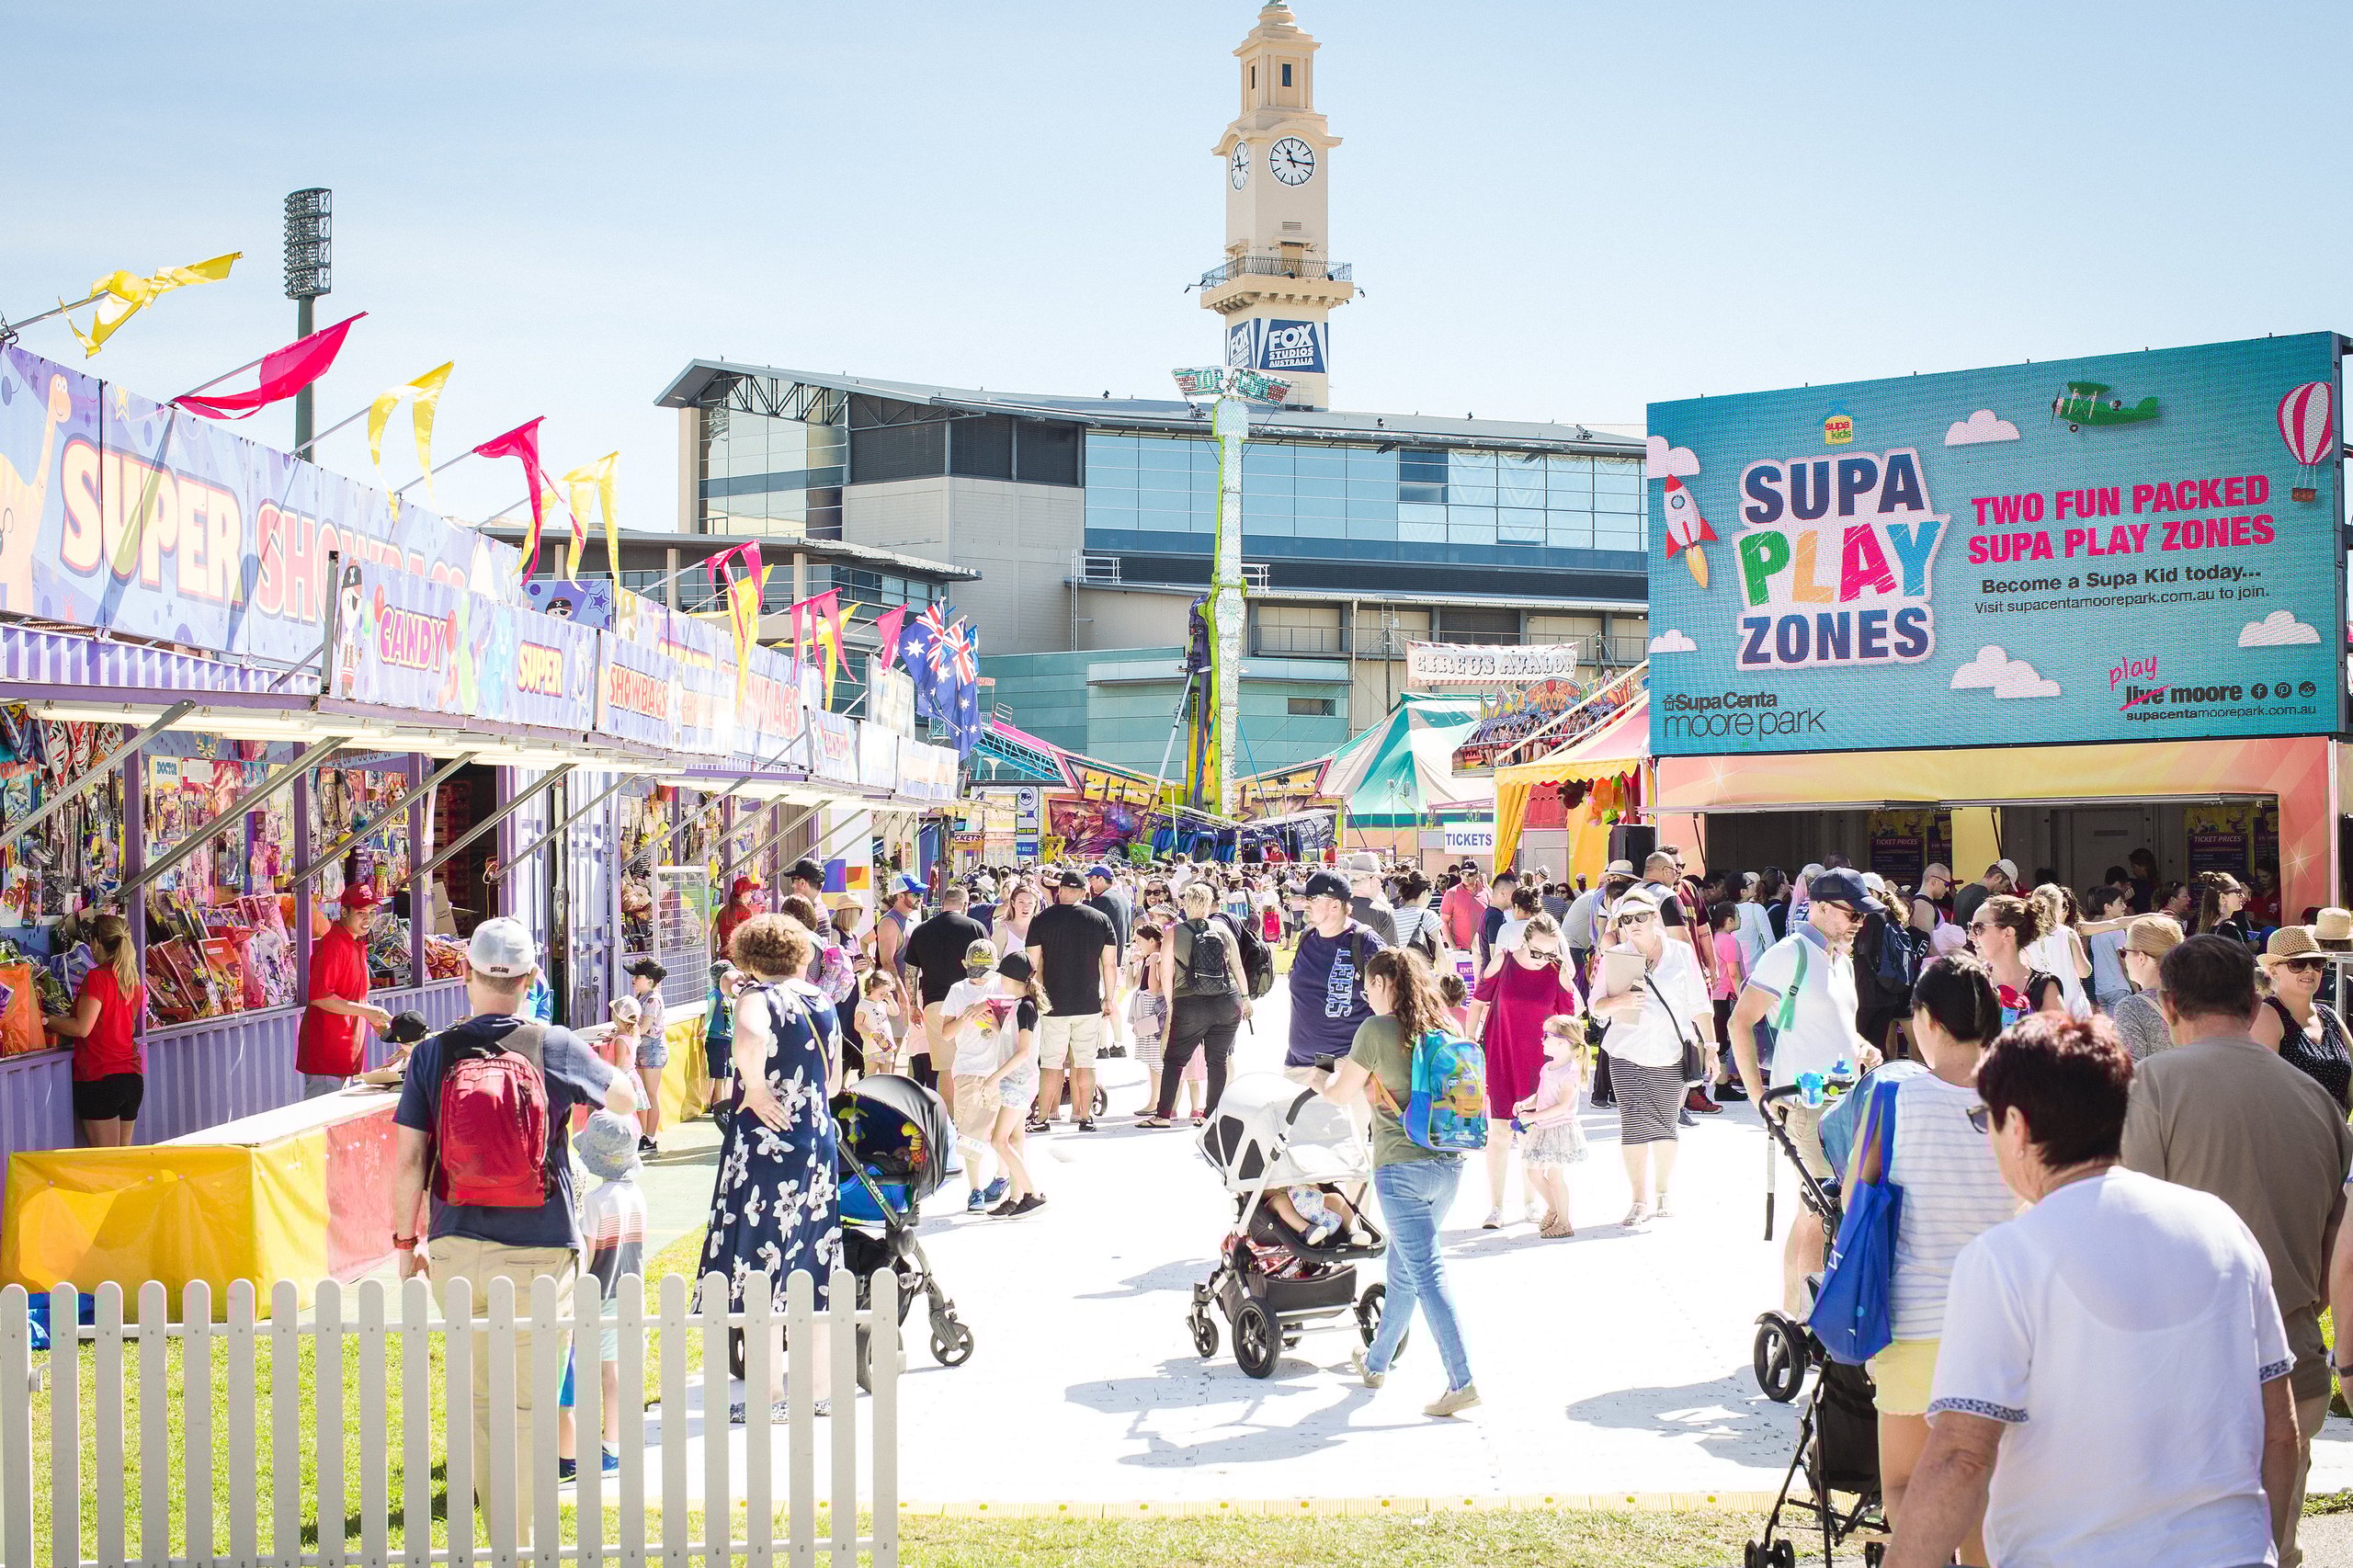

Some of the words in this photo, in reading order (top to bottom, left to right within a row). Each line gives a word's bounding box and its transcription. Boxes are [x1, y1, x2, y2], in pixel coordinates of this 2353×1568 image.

[1269, 324, 1313, 350] FOX
[1269, 347, 1313, 359] STUDIOS
[1269, 358, 1313, 368] AUSTRALIA
[1824, 420, 1849, 431] supa
[1831, 430, 1851, 439] kids
[1745, 453, 1925, 524] SUPA
[1972, 493, 2044, 526] TWO
[2055, 486, 2120, 520] FUN
[2132, 474, 2269, 515] PACKED
[60, 436, 243, 608] SUPER
[1968, 530, 2054, 564] SUPA
[2064, 523, 2151, 558] PLAY
[2161, 514, 2275, 551] ZONES
[1739, 521, 1941, 607] PLAY
[1982, 577, 2062, 594] Become
[2068, 576, 2079, 589] a
[2086, 572, 2137, 589] Supa
[2144, 567, 2177, 584] Kid
[2185, 564, 2261, 582] today...
[1975, 601, 2004, 614] Visit
[2007, 589, 2215, 613] supacentamoorepark.com.au
[2219, 587, 2234, 598] to
[2238, 585, 2269, 601] join.
[378, 604, 449, 674] CANDY
[1743, 607, 1928, 665] ZONES
[517, 641, 563, 698] SUPER
[1415, 654, 1495, 676] CIRCUS
[1500, 654, 1576, 676] AVALON
[2109, 655, 2157, 691] play
[608, 662, 669, 722] SHOWBAGS
[1676, 692, 1778, 713] SupaCenta
[2126, 686, 2165, 705] live
[2171, 685, 2243, 704] moore
[1665, 713, 1754, 737] moore
[1759, 708, 1826, 742] park
[2126, 704, 2316, 722] supacentamoorepark.com.au
[955, 834, 981, 842] CKETS
[1445, 833, 1492, 846] TICKETS
